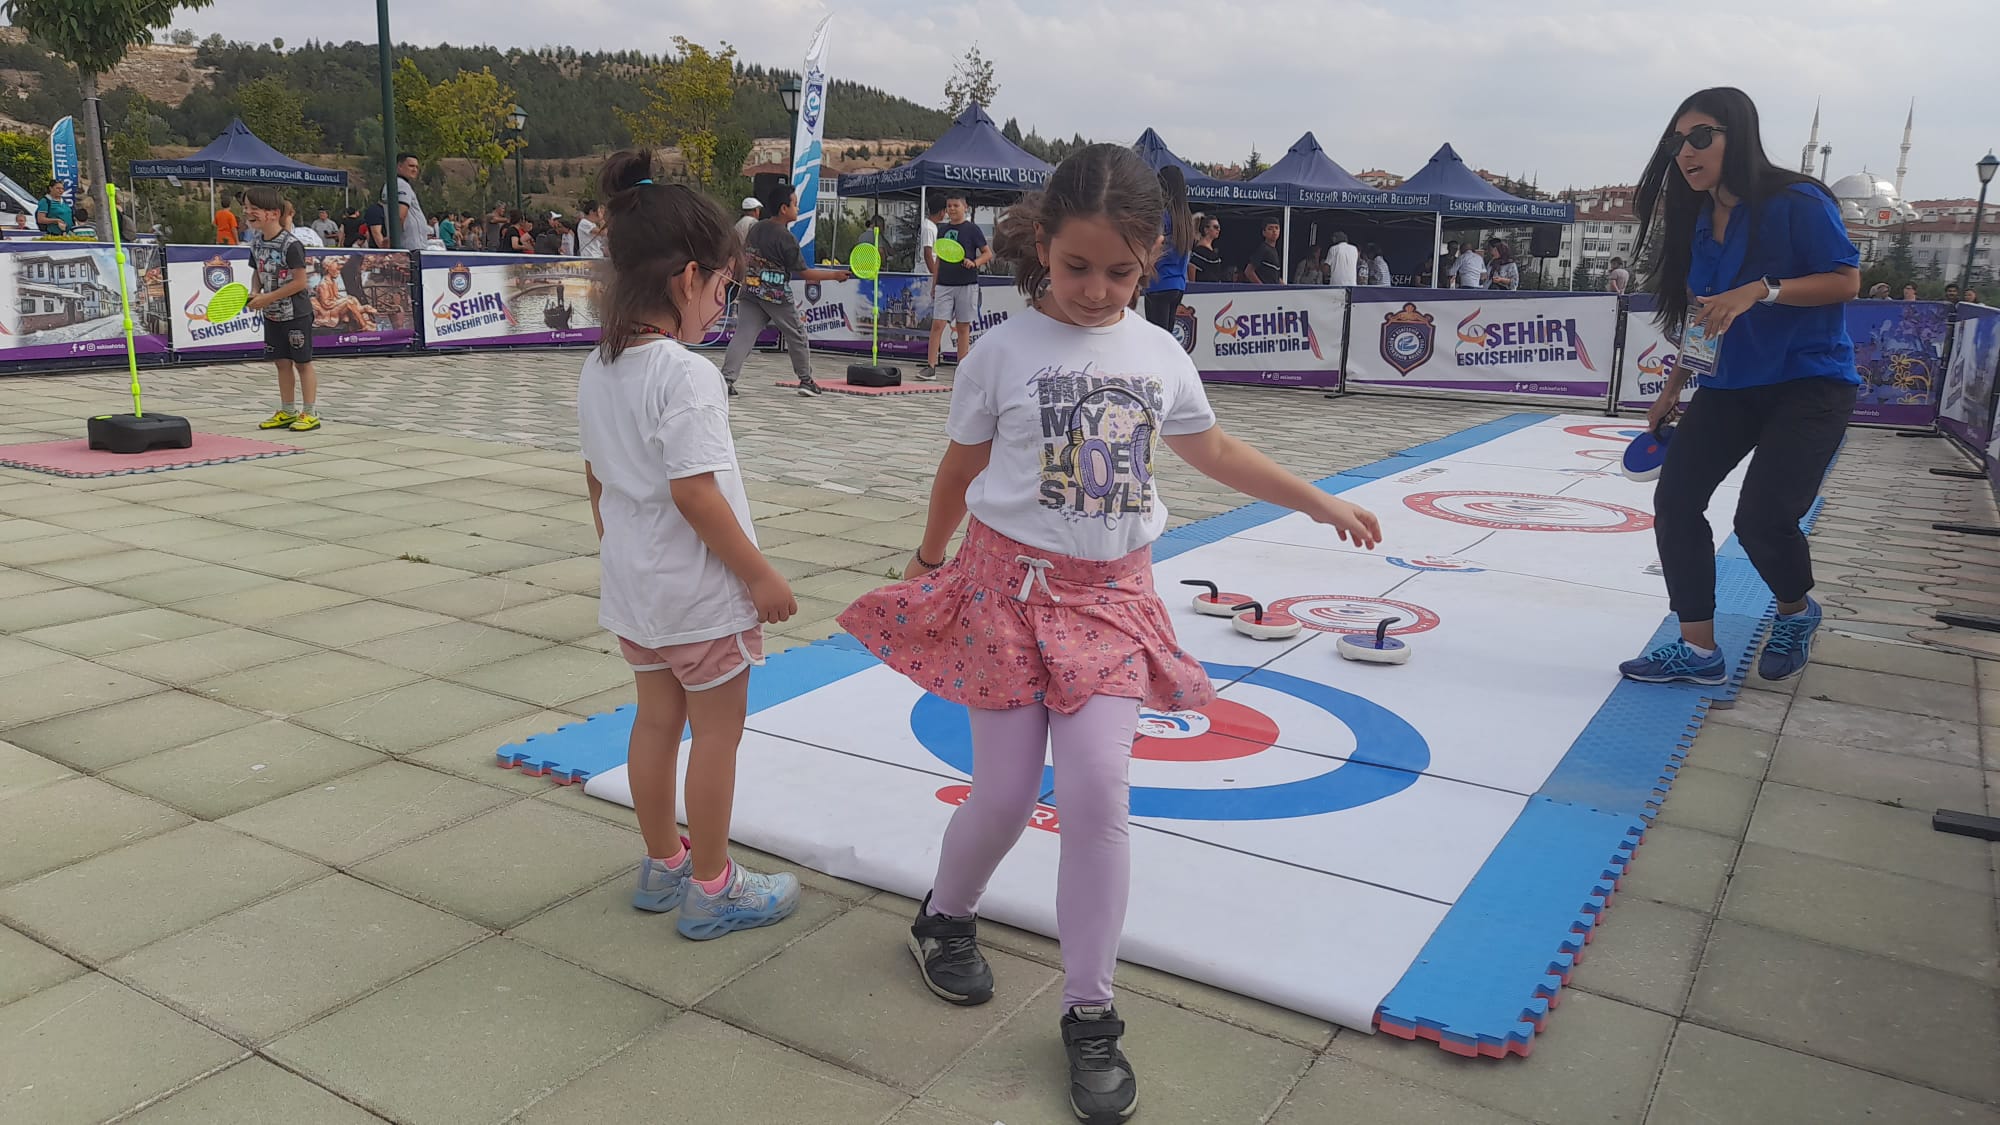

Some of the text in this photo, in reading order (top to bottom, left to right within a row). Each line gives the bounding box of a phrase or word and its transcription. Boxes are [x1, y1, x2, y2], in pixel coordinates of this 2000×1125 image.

[221, 166, 340, 183] ESKİŞEHİR BÜYÜKŞEHİR BELEDİYESİ
[944, 165, 1013, 182] ESKİŞEHİR
[1233, 186, 1277, 200] BELEDİYESİ
[1300, 189, 1430, 206] ESKİŞEHİR BÜYÜKŞEHİR BELEDİYESİ
[1450, 199, 1567, 218] ESKİŞEHİR BÜYÜKŞEHİR BELEDİYESİ
[1215, 335, 1300, 356] ESKİŞEHİR'DİR
[1456, 345, 1565, 366] ESKİŞEHİR'DİR
